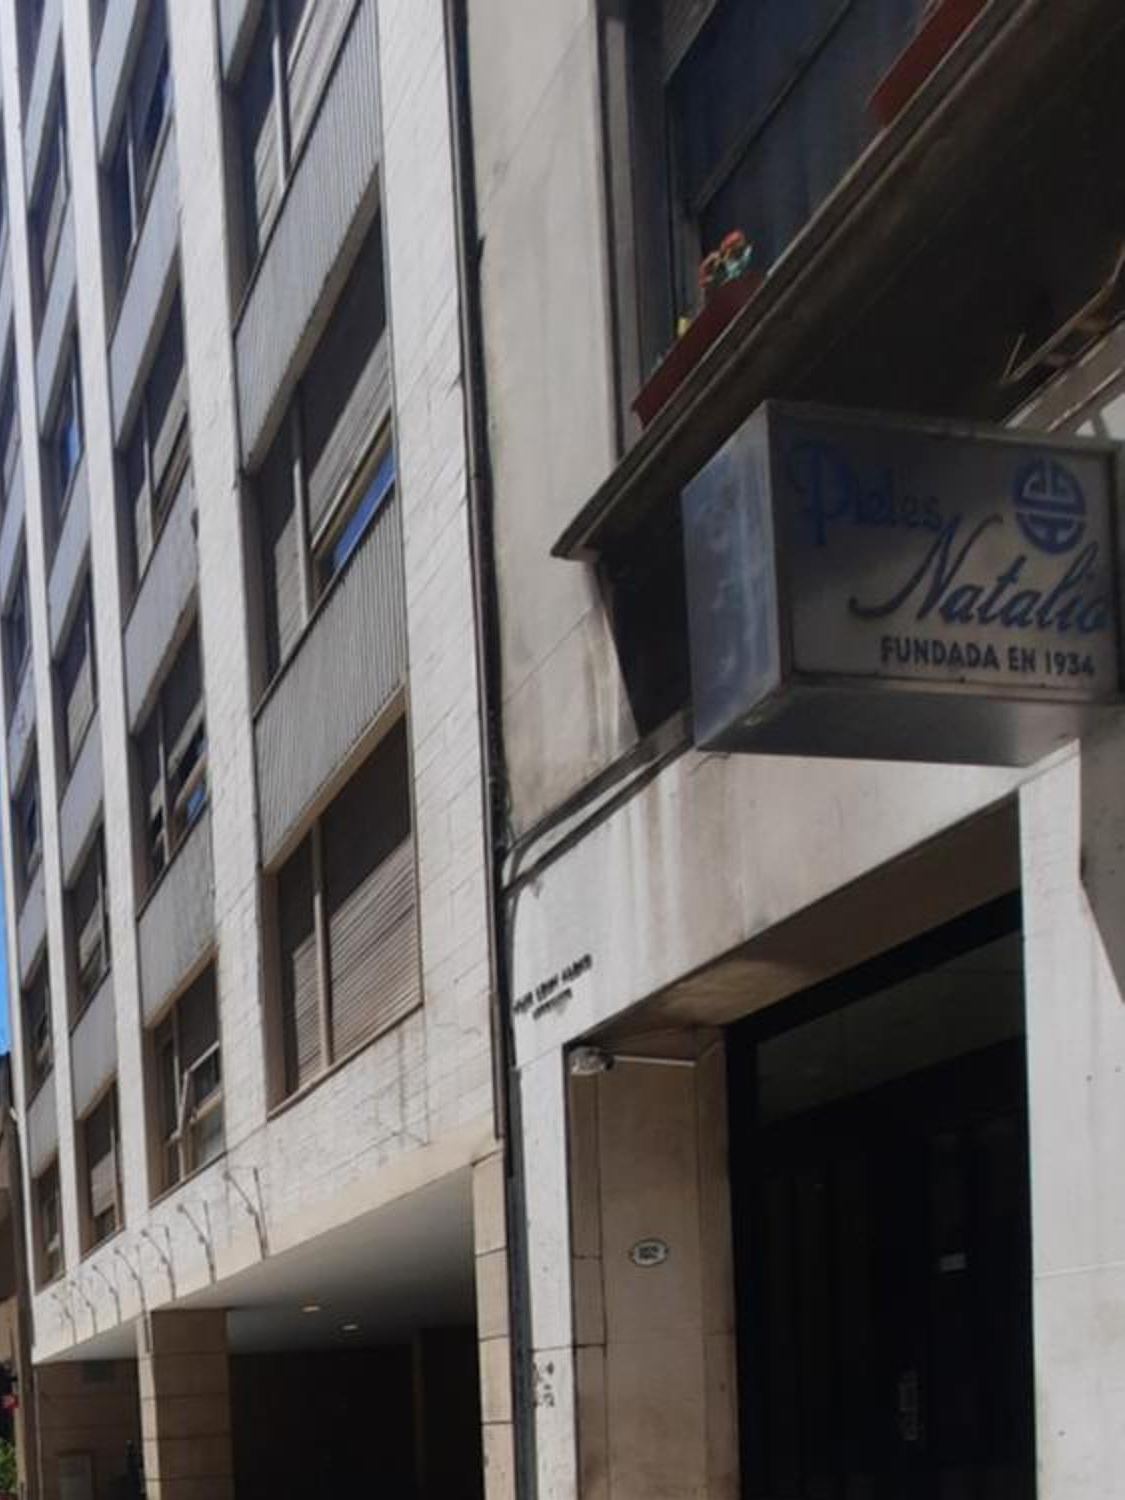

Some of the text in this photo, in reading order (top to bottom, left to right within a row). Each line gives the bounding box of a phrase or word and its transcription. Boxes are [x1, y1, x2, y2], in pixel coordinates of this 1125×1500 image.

[787, 440, 940, 546] Pieles
[849, 513, 1111, 635] Natalio
[880, 636, 1096, 677] FUNDADA EN 1934
